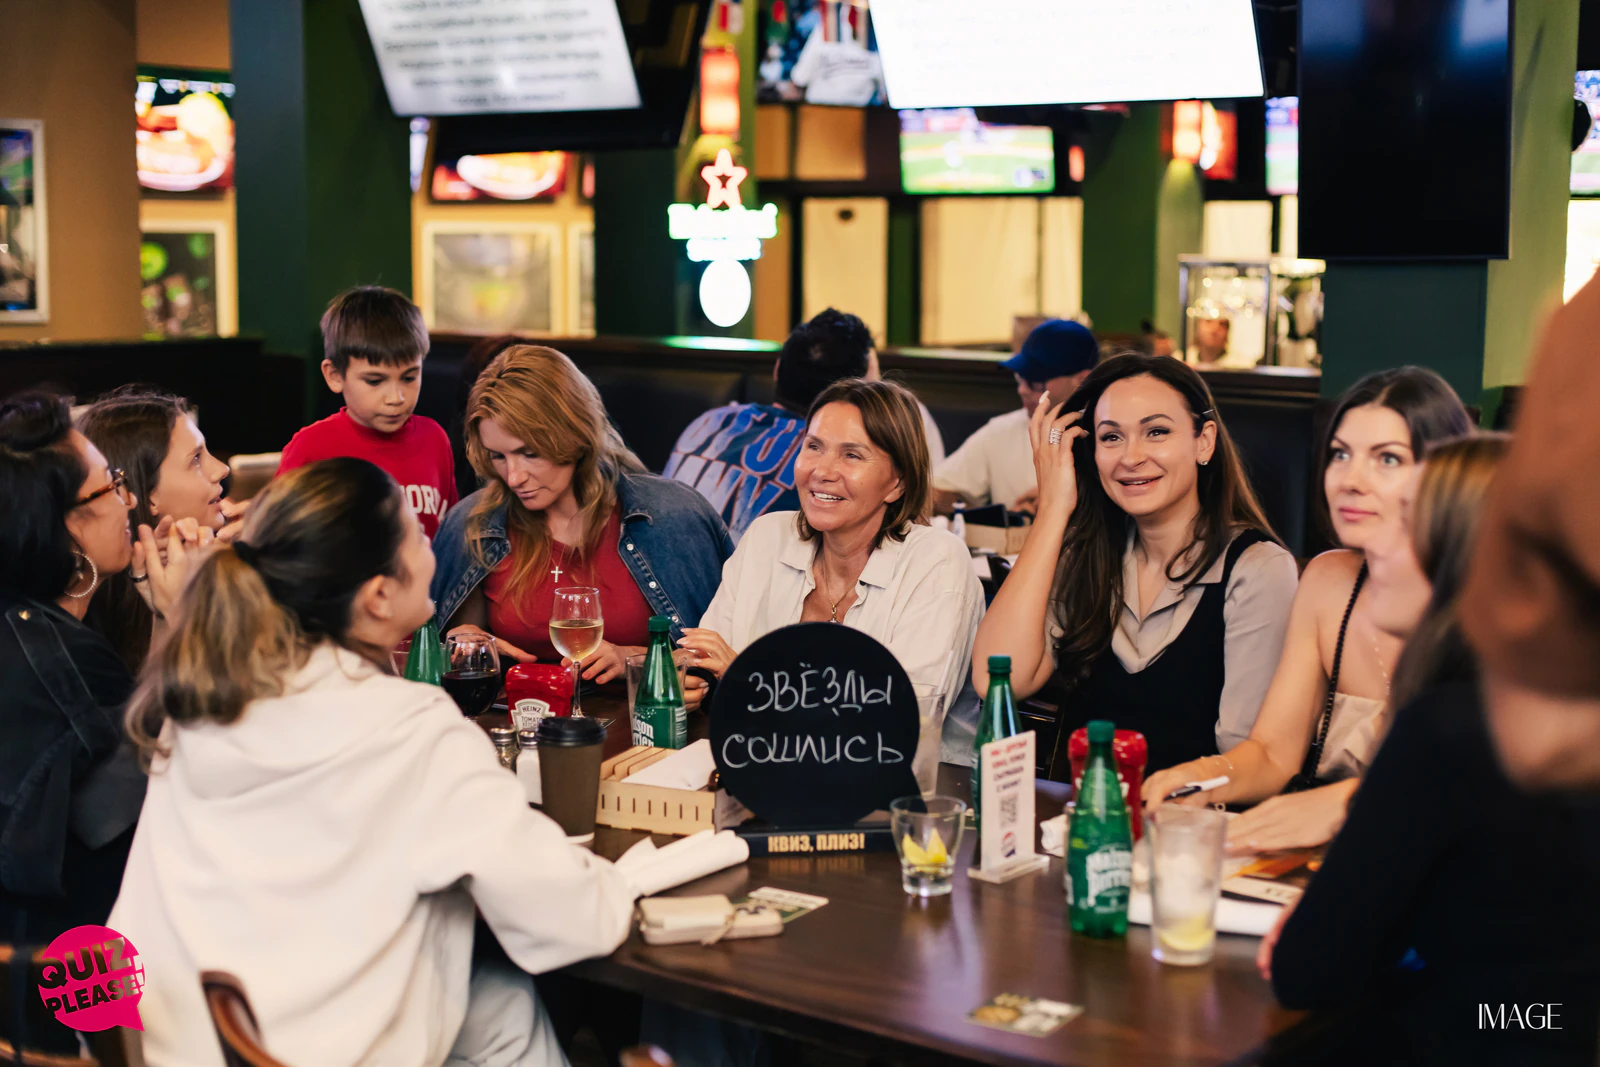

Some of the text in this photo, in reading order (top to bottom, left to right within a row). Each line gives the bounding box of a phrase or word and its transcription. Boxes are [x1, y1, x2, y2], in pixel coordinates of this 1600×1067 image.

[747, 662, 892, 716] ЗВЁЗДЫ
[522, 705, 542, 713] HEINZ
[722, 732, 904, 768] СОШЛИСЬ
[768, 832, 865, 853] КВИЗ, ПЛИЗ!
